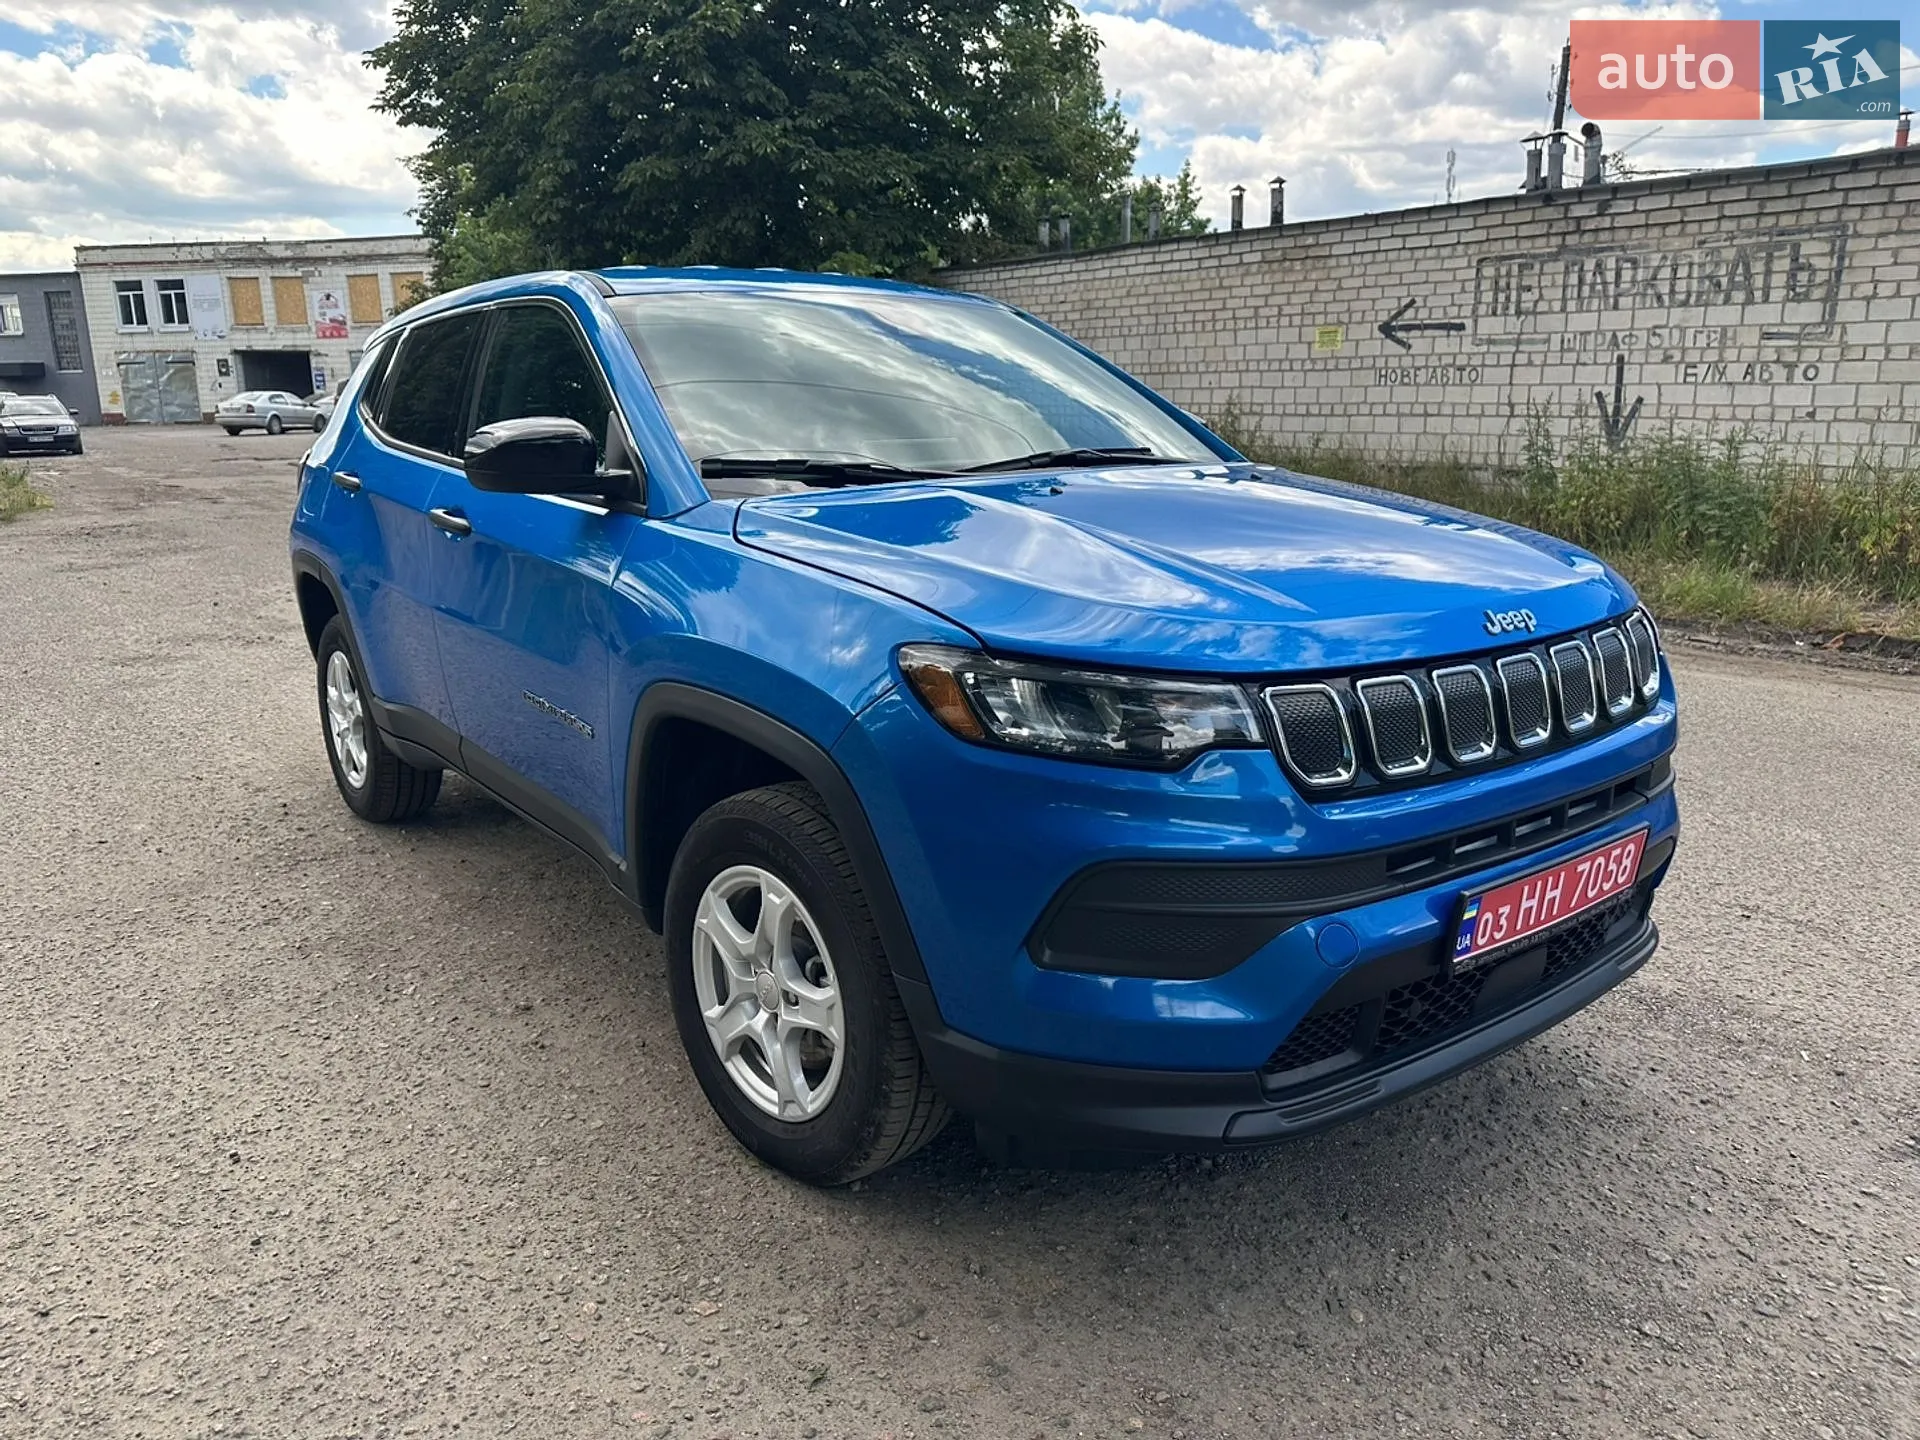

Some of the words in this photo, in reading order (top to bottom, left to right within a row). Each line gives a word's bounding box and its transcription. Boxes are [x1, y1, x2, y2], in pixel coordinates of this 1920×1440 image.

[1491, 259, 1536, 316] НЕ
[1562, 242, 1817, 312] ПАРКОВАТЬ
[1743, 363, 1820, 383] АВТО
[1485, 608, 1537, 634] Jeep
[1475, 904, 1511, 947] 03
[1516, 871, 1565, 931] HH
[1570, 843, 1635, 909] 7058
[1456, 933, 1471, 951] UA
